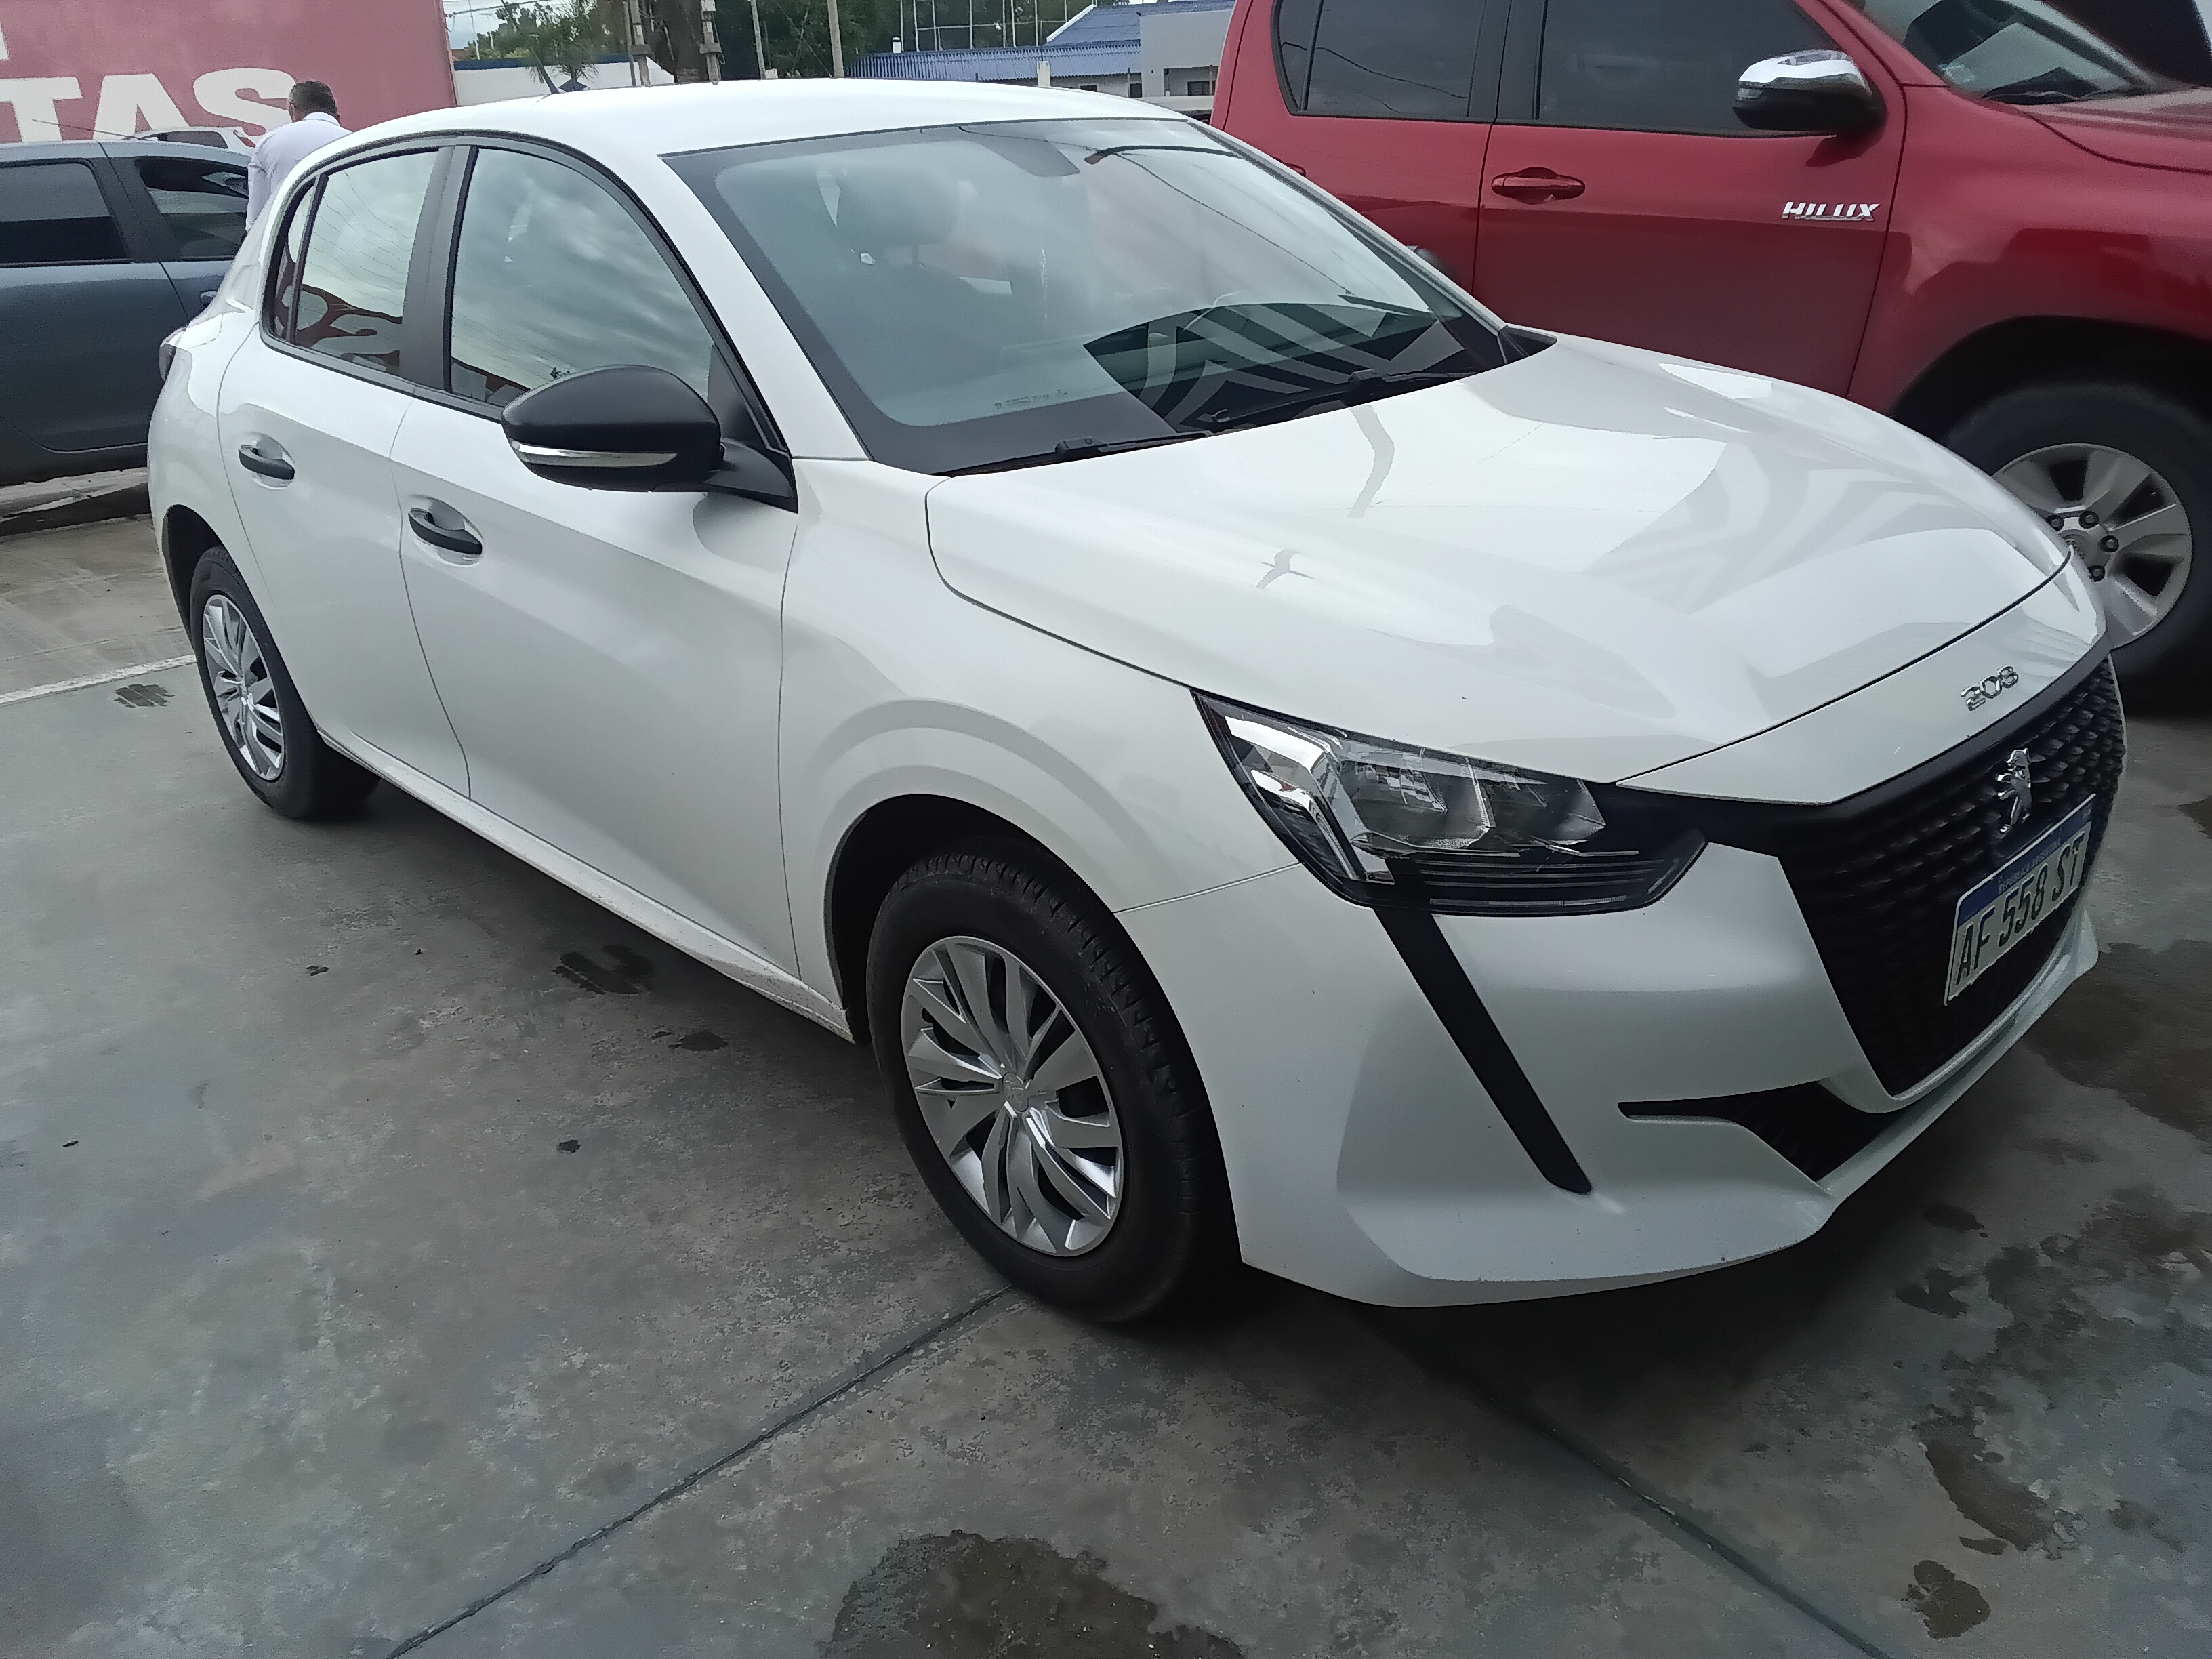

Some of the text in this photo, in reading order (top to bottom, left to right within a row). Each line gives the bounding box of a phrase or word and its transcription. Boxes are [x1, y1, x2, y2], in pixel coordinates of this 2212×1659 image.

[1781, 201, 1880, 222] HILUX
[1961, 664, 2019, 711] 208
[1954, 905, 1996, 986] AF
[1998, 862, 2048, 947] 558
[2052, 831, 2085, 901] ST
